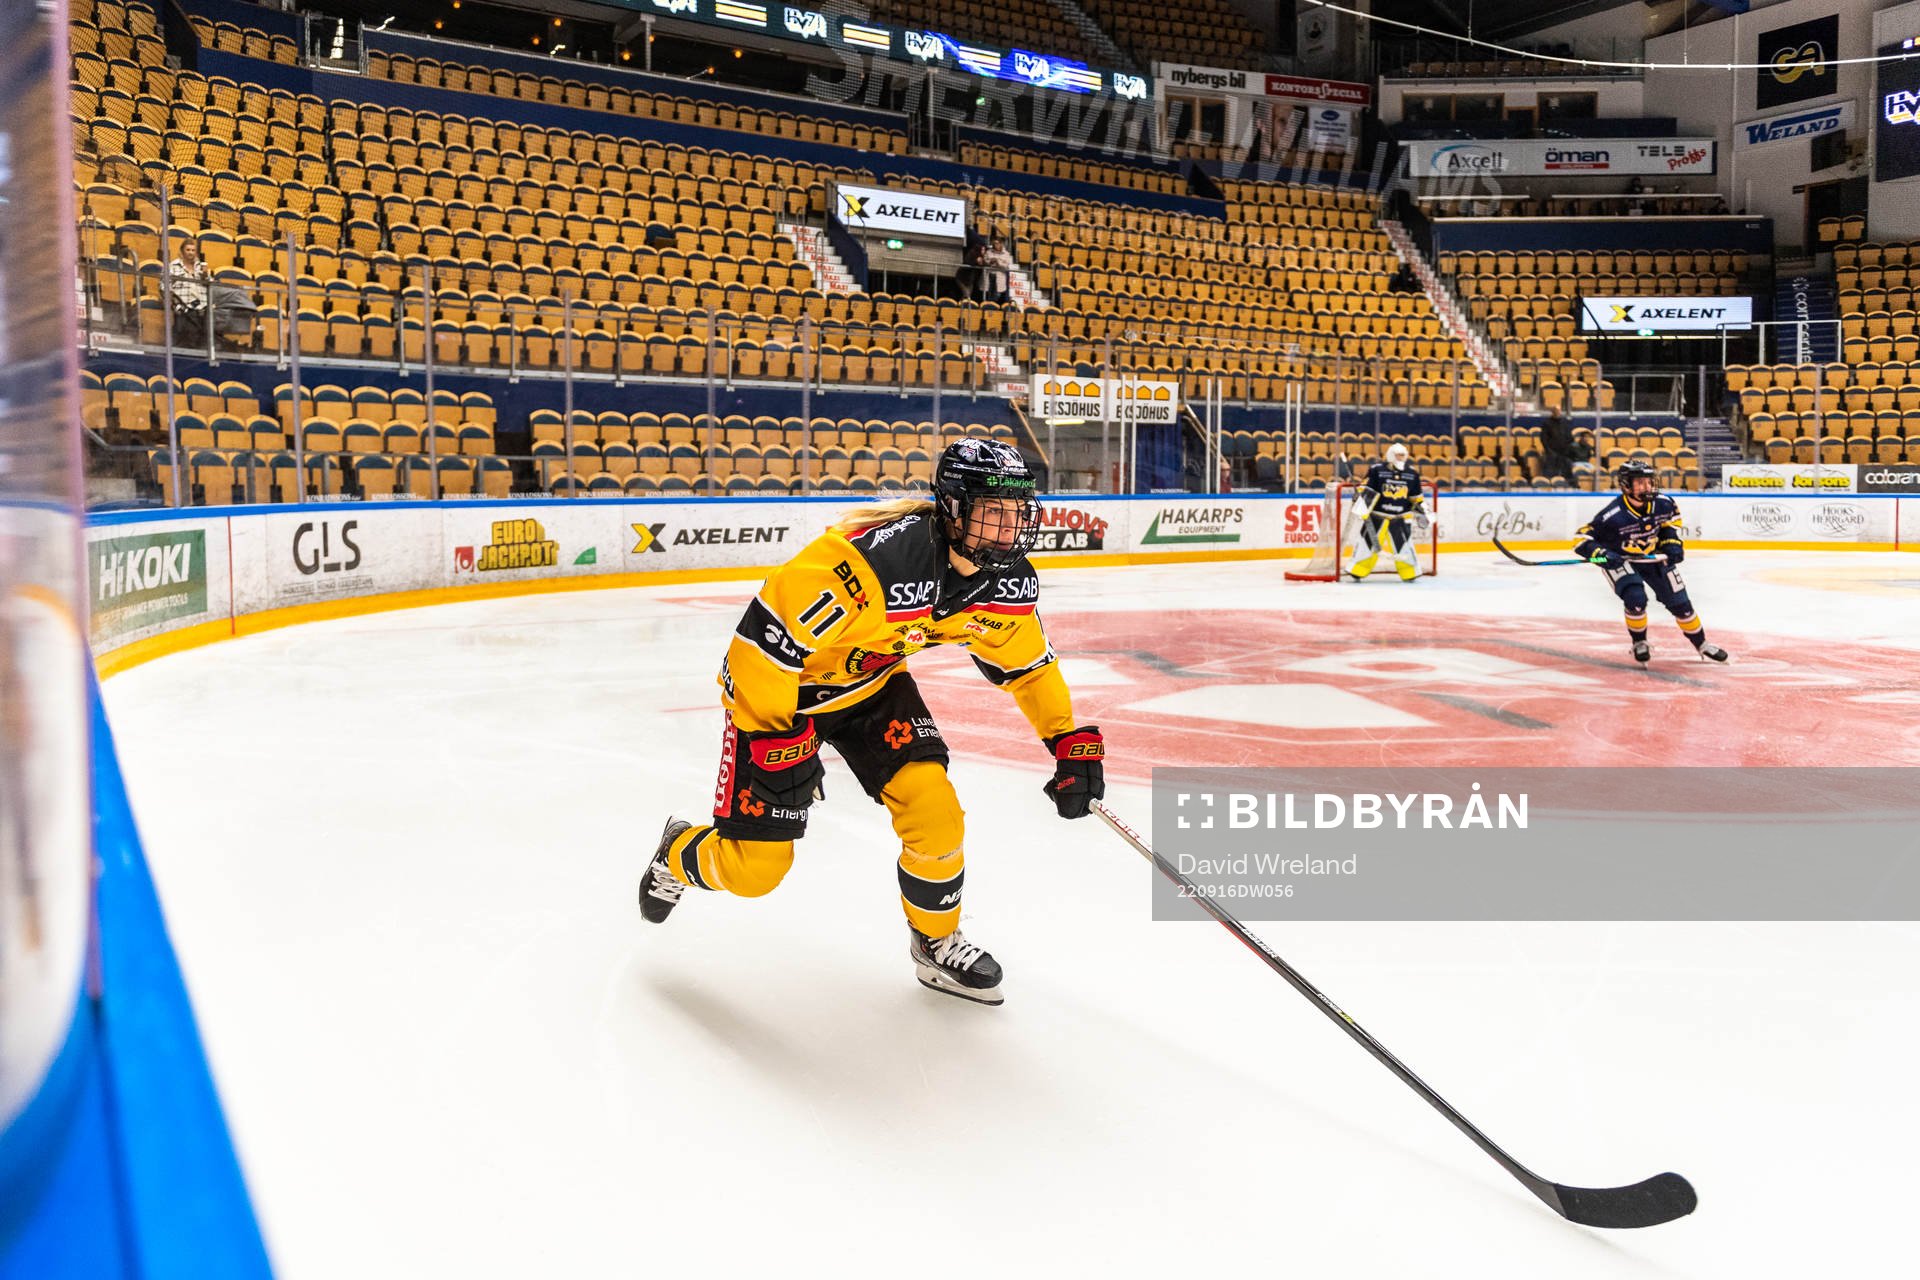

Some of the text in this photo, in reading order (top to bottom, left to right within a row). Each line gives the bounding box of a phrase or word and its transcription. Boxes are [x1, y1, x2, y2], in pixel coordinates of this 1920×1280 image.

[1171, 67, 1246, 88] nybergs bil
[1746, 107, 1842, 144] WELAND
[1448, 152, 1502, 169] Axcell
[1544, 148, 1610, 162] öman
[1637, 146, 1685, 156] TELE
[875, 204, 960, 224] AXELENT
[1640, 308, 1726, 319] AXELENT
[1033, 507, 1109, 539] AHOVS
[1161, 507, 1244, 525] HAKARPS
[491, 518, 541, 545] EURO
[672, 526, 790, 546] AXELENT
[1178, 525, 1226, 534] EQUIPMENT
[1284, 533, 1319, 544] EUROD
[292, 519, 362, 576] GLS
[1060, 532, 1089, 548] AB
[477, 540, 558, 572] JACKPOT
[994, 576, 1038, 600] SSAB
[797, 588, 848, 640] 11
[911, 717, 936, 727] Lule
